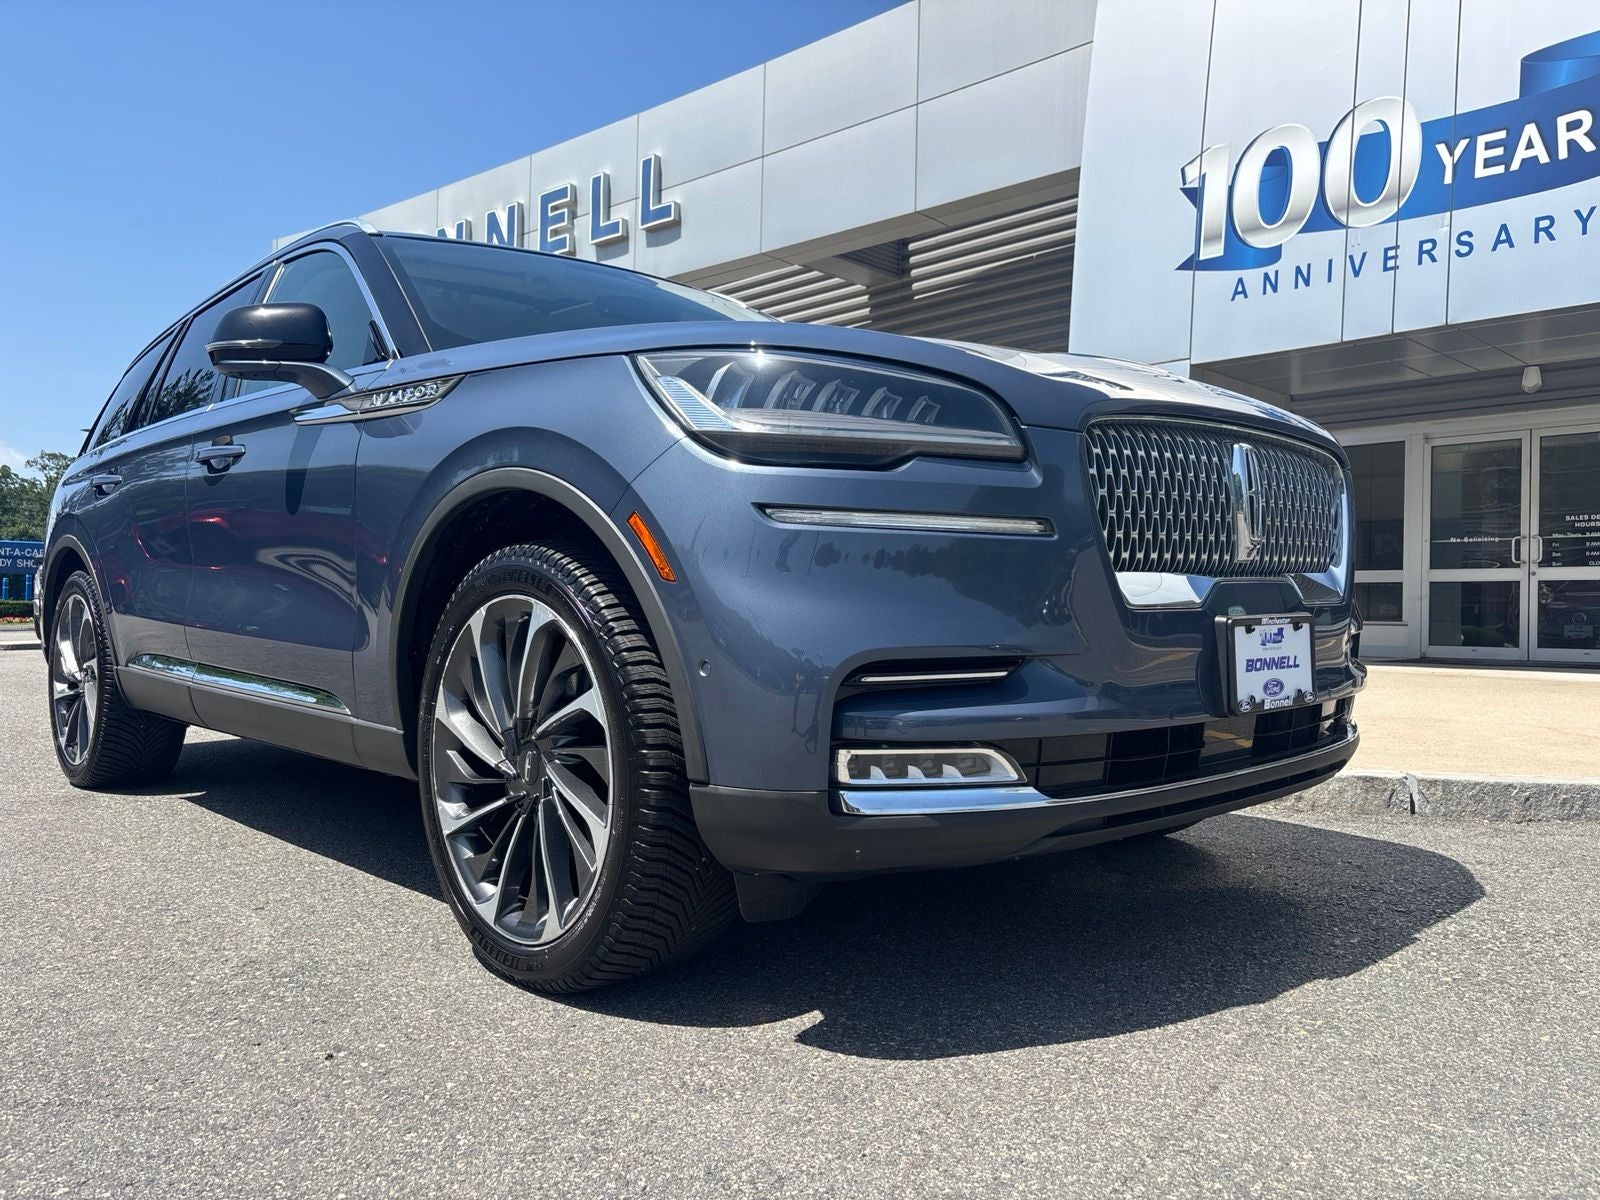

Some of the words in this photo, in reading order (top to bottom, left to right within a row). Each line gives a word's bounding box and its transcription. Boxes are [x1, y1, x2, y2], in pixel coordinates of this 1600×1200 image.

[1180, 96, 1423, 261] 100
[1435, 109, 1597, 185] YEAR
[1231, 205, 1597, 301] ANNIVERSARY
[1245, 656, 1299, 672] BONNELL
[1264, 697, 1293, 709] Bonnell
